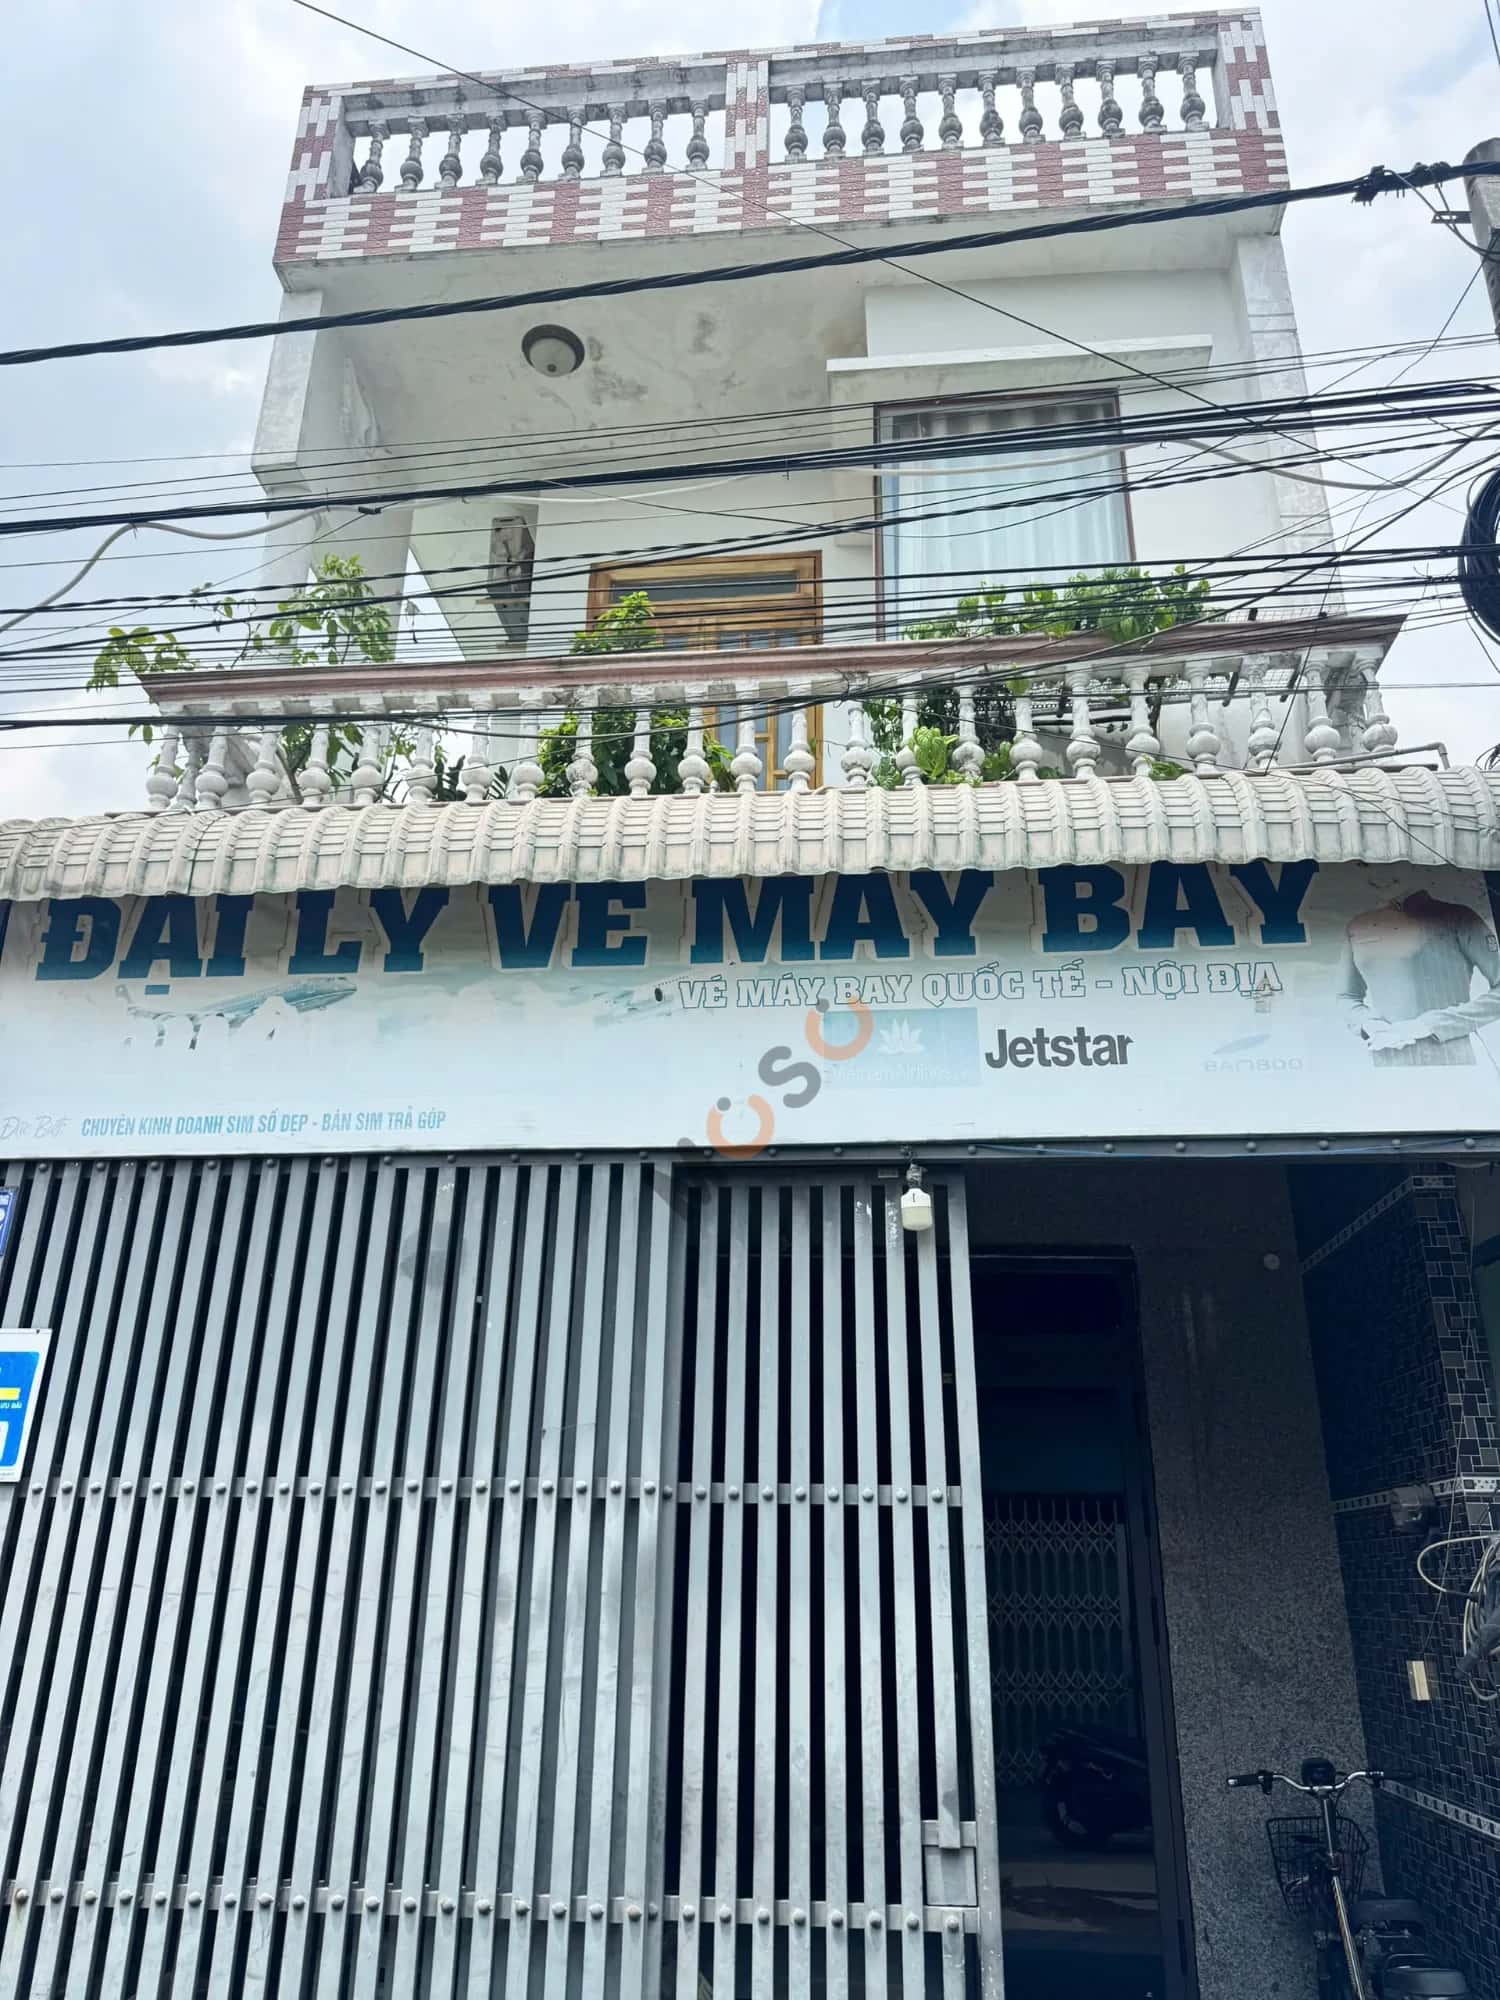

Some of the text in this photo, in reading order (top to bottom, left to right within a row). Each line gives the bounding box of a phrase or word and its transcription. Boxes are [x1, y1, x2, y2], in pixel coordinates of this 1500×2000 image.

[35, 893, 255, 996] ĐẠI
[1037, 859, 1319, 953] BAY
[678, 974, 728, 1009] VÉ
[736, 972, 826, 1008] MÁY
[834, 974, 913, 1006] BAY
[921, 960, 1025, 1008] QUỐC
[1032, 958, 1087, 999] TẾ
[1121, 959, 1200, 1000] NỘI
[1206, 961, 1284, 998] ĐỊA
[984, 1025, 1135, 1070] Jetstar
[138, 1116, 173, 1136] KINH
[174, 1115, 225, 1136] DOANH
[226, 1114, 254, 1134] SIM
[257, 1107, 279, 1133] SỐ
[321, 1108, 352, 1132] BÁN
[355, 1112, 384, 1132] SIM
[417, 1107, 447, 1130] GÓP
